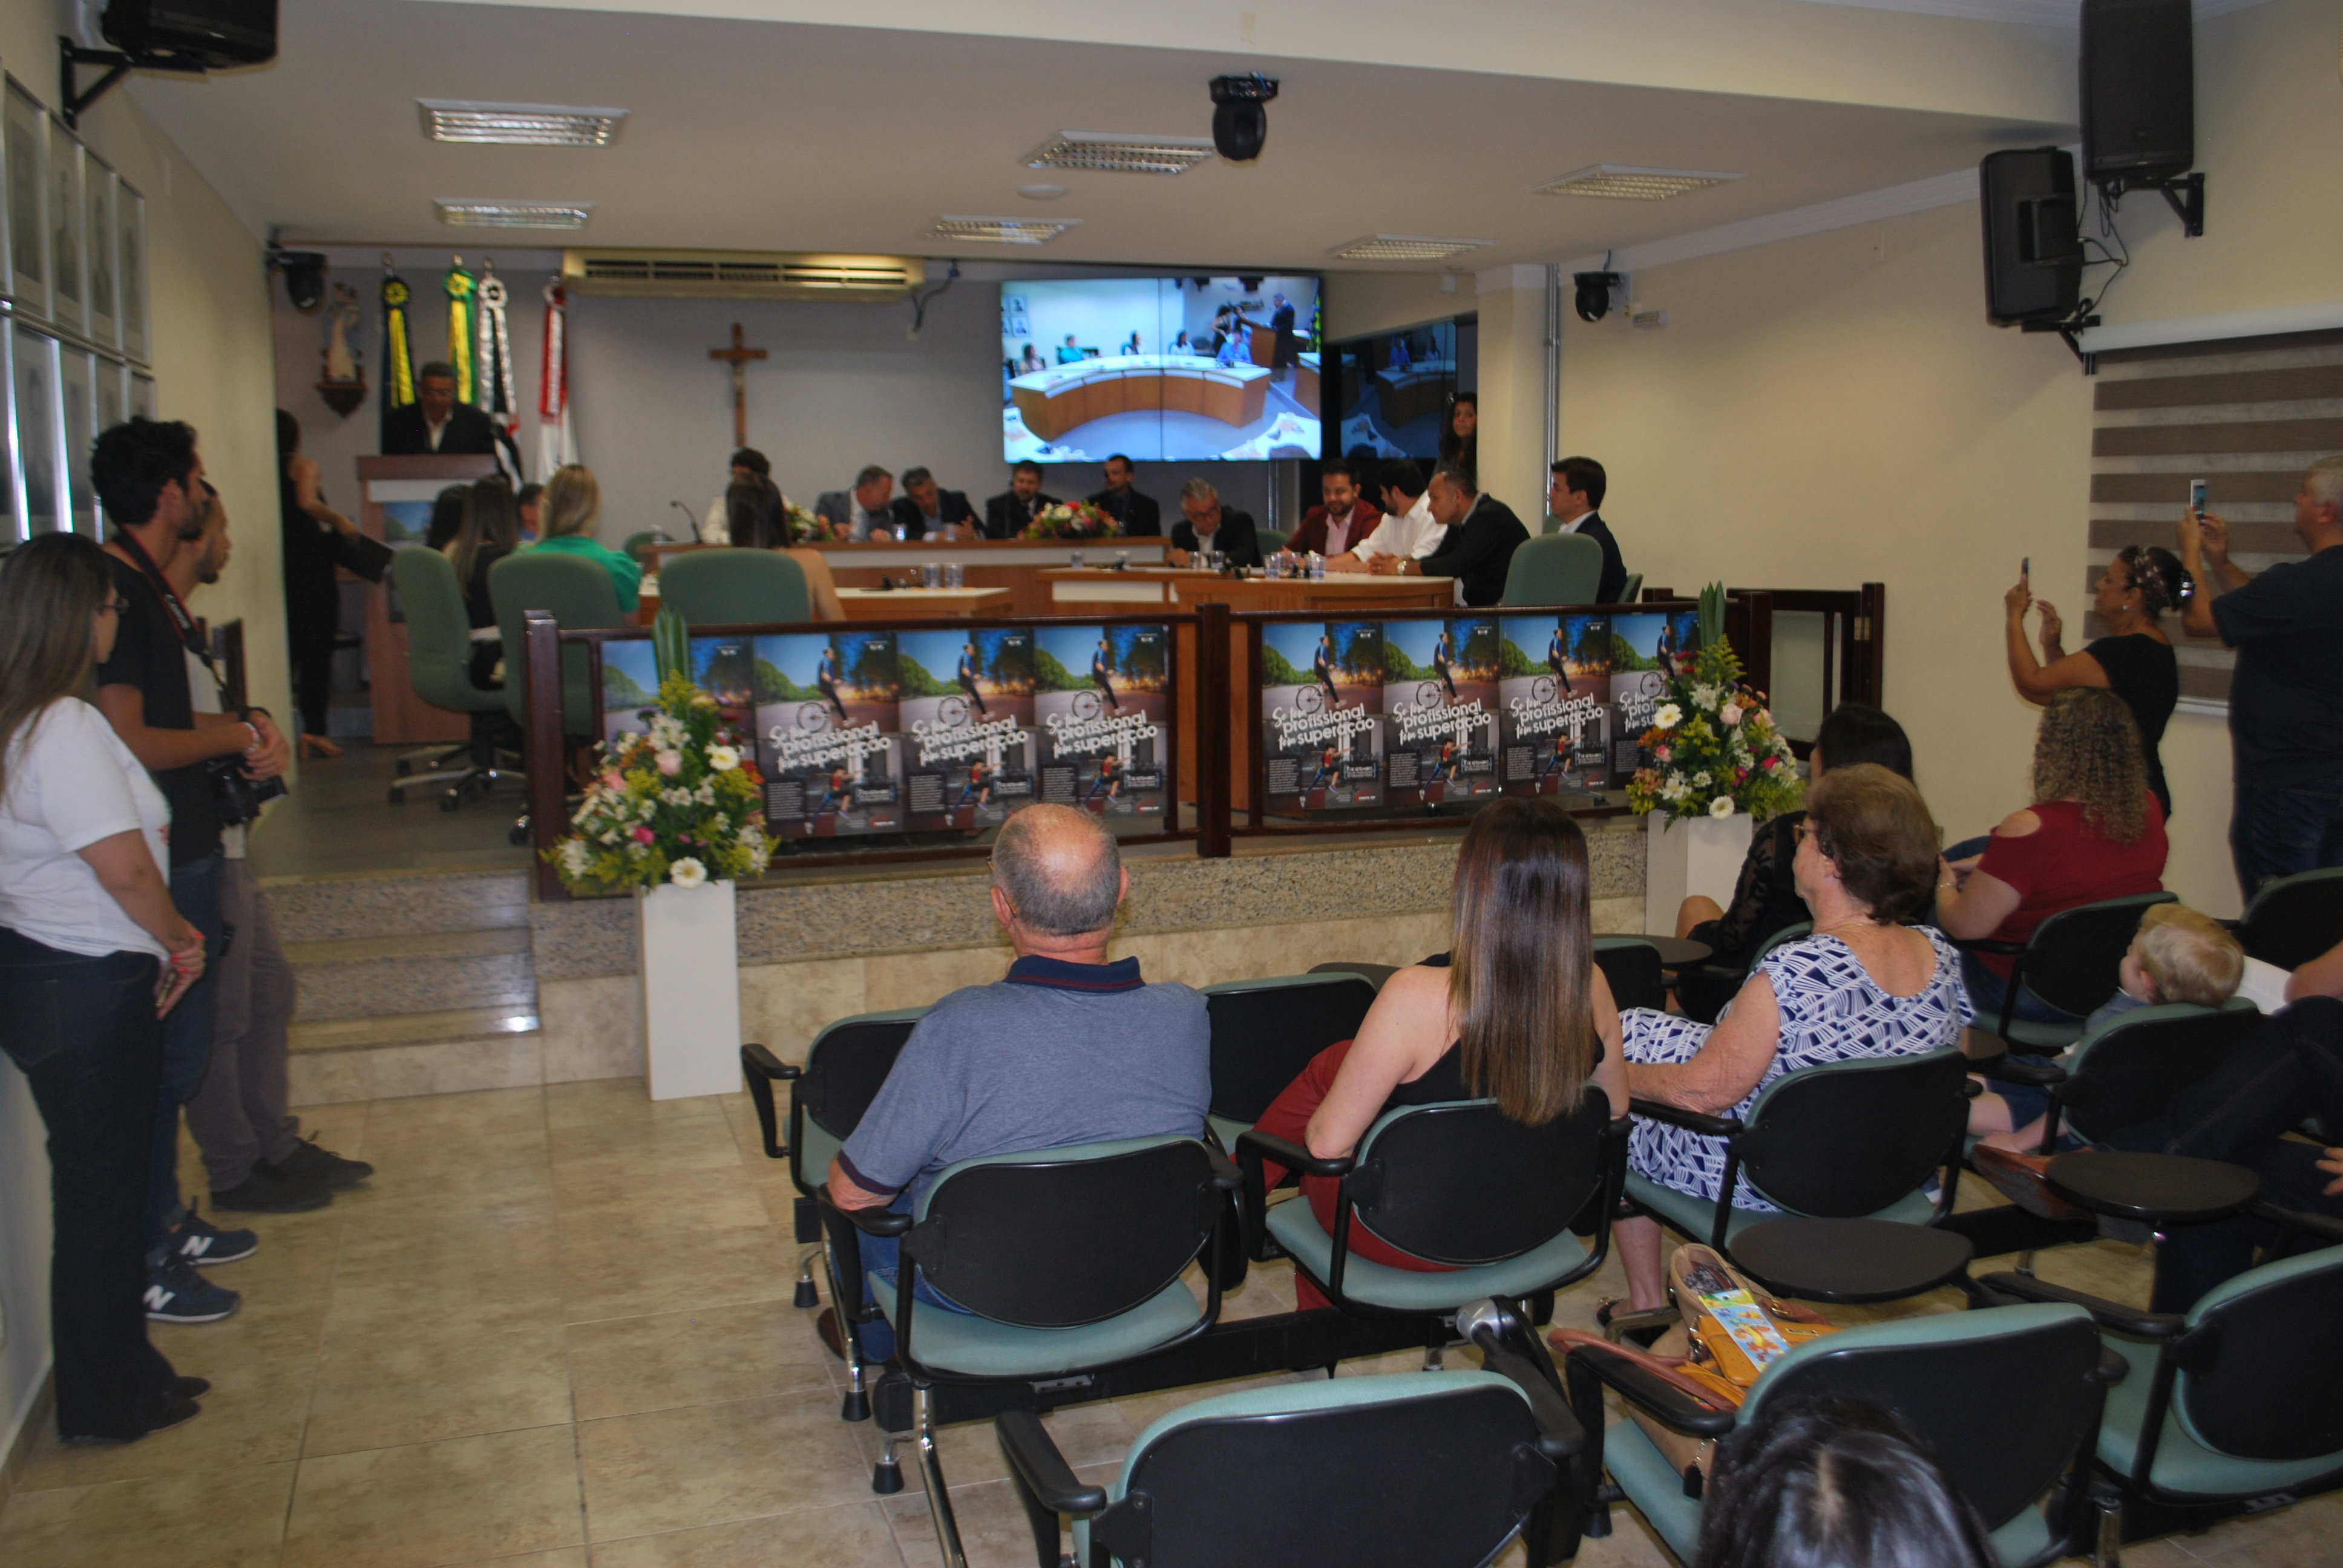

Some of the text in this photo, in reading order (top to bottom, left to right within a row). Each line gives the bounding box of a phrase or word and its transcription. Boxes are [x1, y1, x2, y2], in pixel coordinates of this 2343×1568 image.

[1393, 702, 1406, 723] Se
[1403, 697, 1482, 733] profissional
[1510, 696, 1524, 717] Se
[1519, 691, 1594, 727] profissional
[1619, 691, 1631, 711] Se
[1058, 709, 1147, 745] profissional
[1272, 707, 1286, 728] Se
[1282, 702, 1365, 738] profissional
[1297, 717, 1375, 746] superação
[1417, 713, 1492, 742] superação
[1533, 707, 1604, 735] superação
[782, 720, 880, 757] profissional
[923, 714, 1018, 752] profissional
[940, 730, 1029, 762] superação
[1073, 725, 1158, 754] superação
[180, 1235, 214, 1256] N
